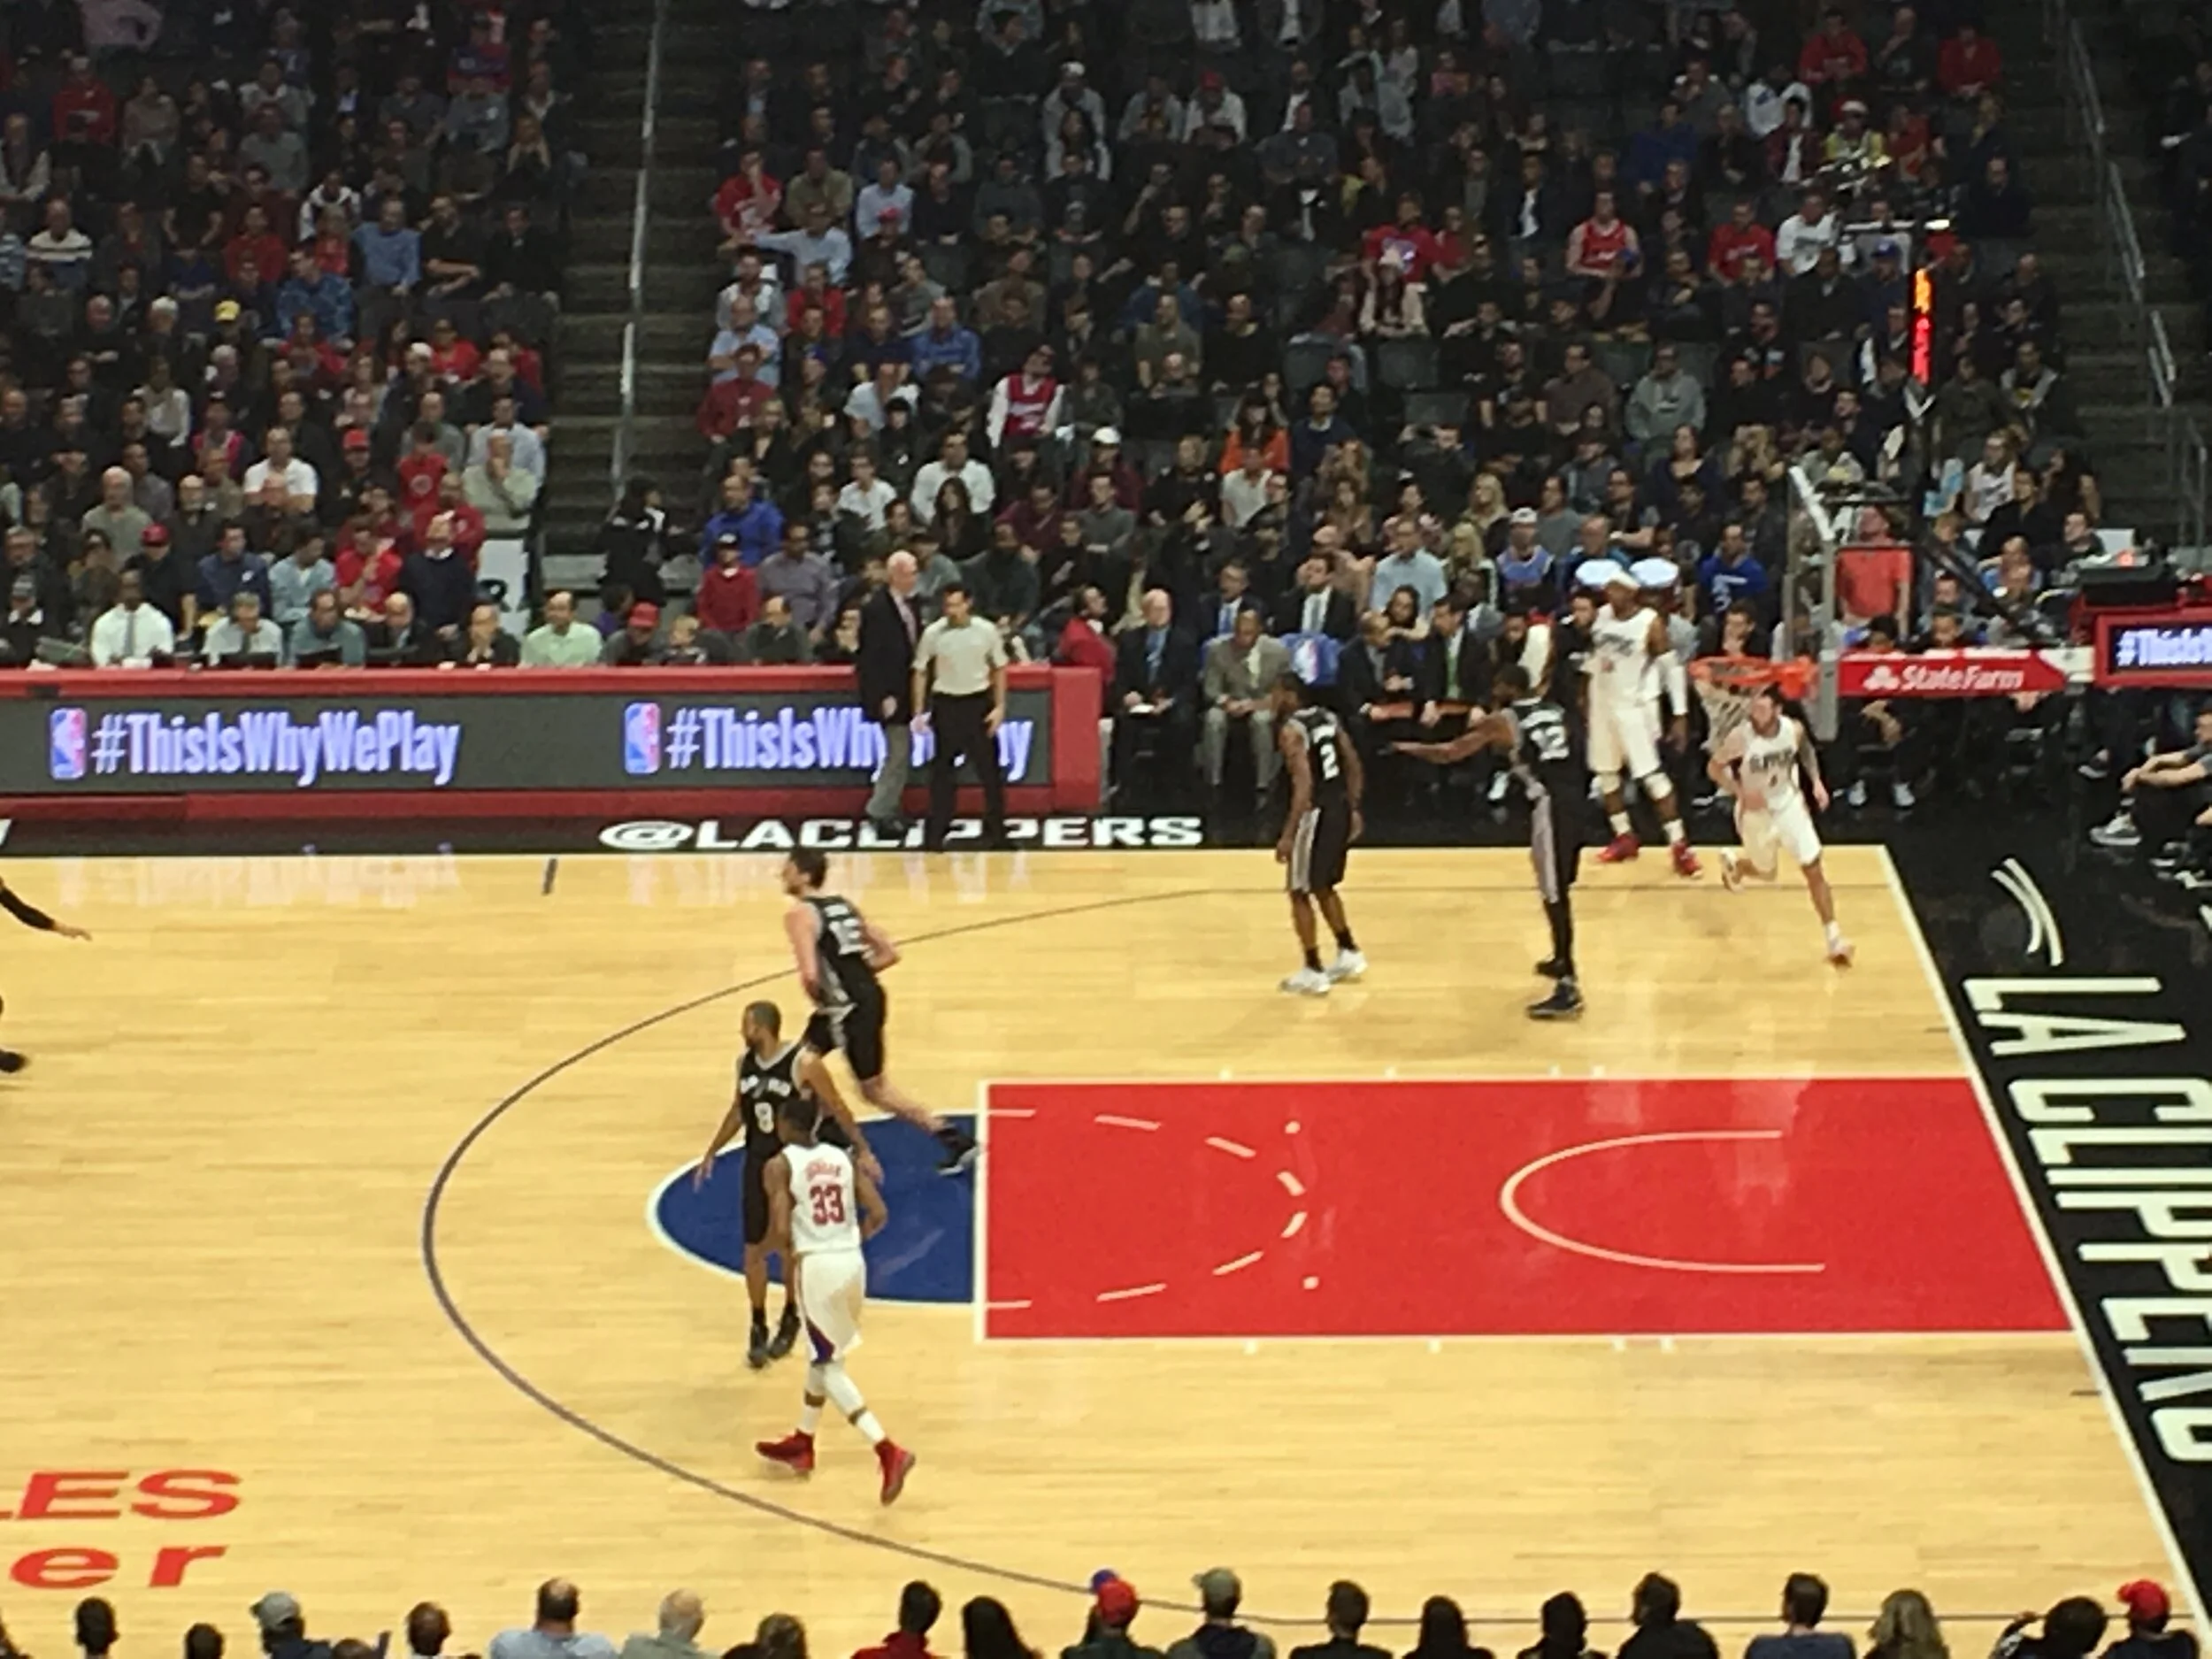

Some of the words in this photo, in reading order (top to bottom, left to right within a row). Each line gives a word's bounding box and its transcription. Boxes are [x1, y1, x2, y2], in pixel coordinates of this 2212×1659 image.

[91, 710, 459, 787] #ThisIsWhyWePlay
[1319, 742, 1340, 780] 2
[1962, 977, 2187, 1056] LA
[810, 1183, 845, 1226] 33
[0, 1469, 242, 1520] ES
